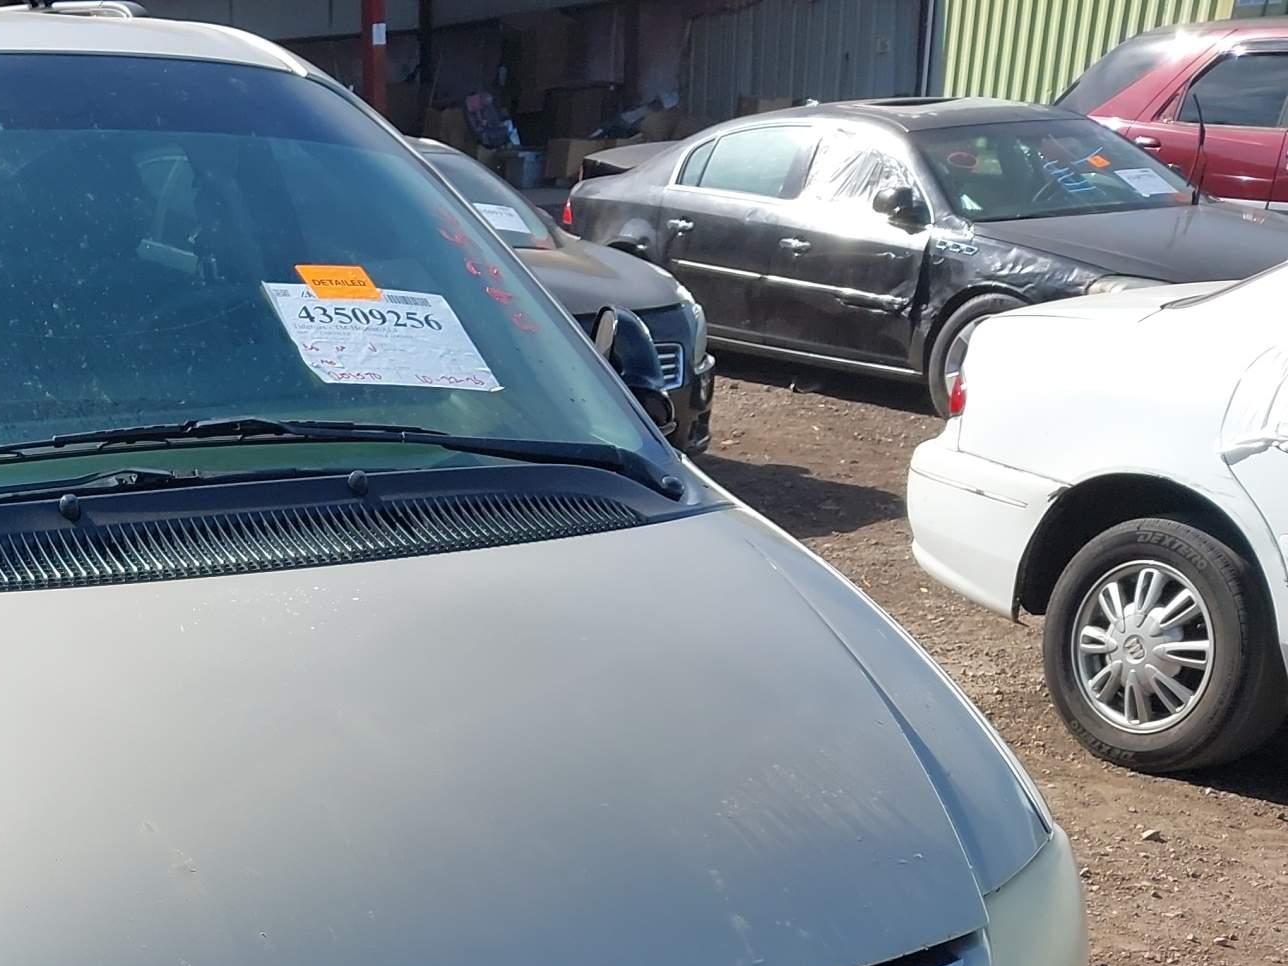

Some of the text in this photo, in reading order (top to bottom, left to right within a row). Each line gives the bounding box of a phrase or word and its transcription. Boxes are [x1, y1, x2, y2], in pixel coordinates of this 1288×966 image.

[311, 279, 367, 287] DETAILED
[298, 305, 442, 331] 43509256
[1135, 531, 1208, 571] DEXTERO
